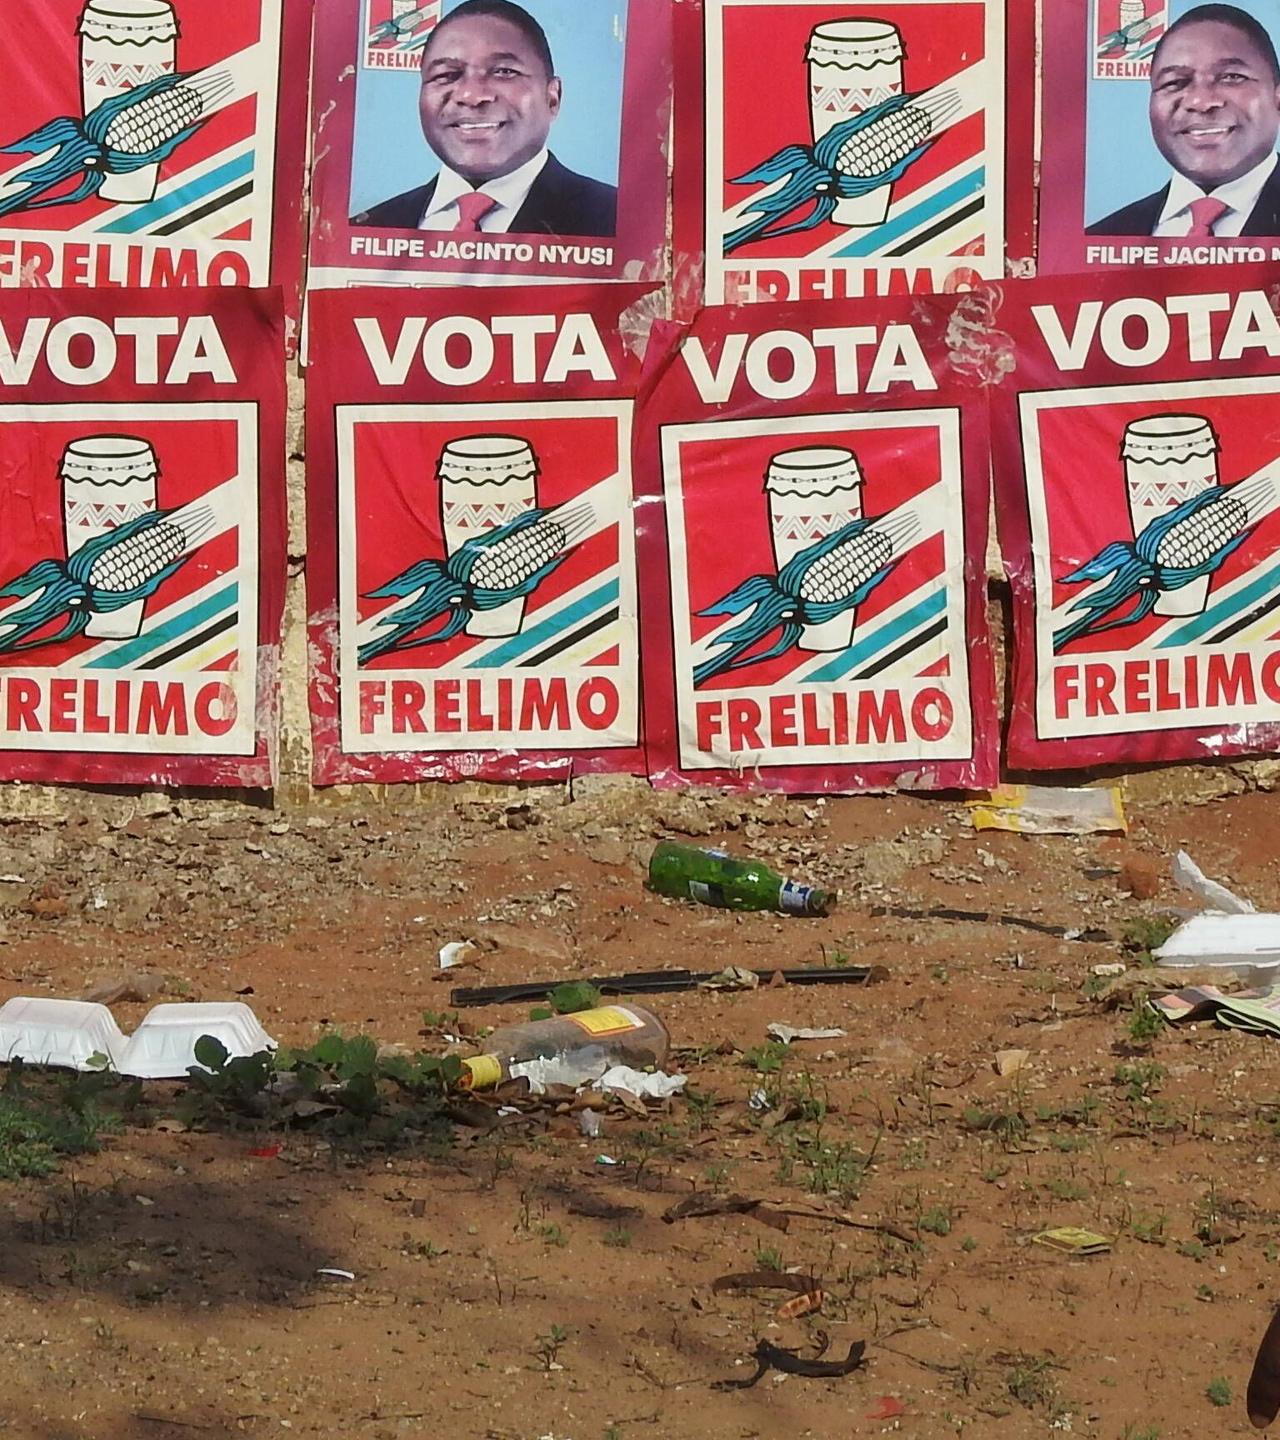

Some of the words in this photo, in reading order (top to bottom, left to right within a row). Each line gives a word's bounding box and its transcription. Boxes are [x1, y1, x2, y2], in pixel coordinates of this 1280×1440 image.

[350, 236, 424, 257] FILIPE
[429, 239, 533, 262] JACINTO
[538, 245, 614, 266] NYUSI
[1086, 245, 1160, 264] FILIPE
[1164, 246, 1265, 265] JACINTO
[354, 314, 616, 386] VOTA
[678, 324, 938, 404] VOTA
[358, 675, 621, 737] FRELIMO
[696, 687, 952, 754] FRELIMO
